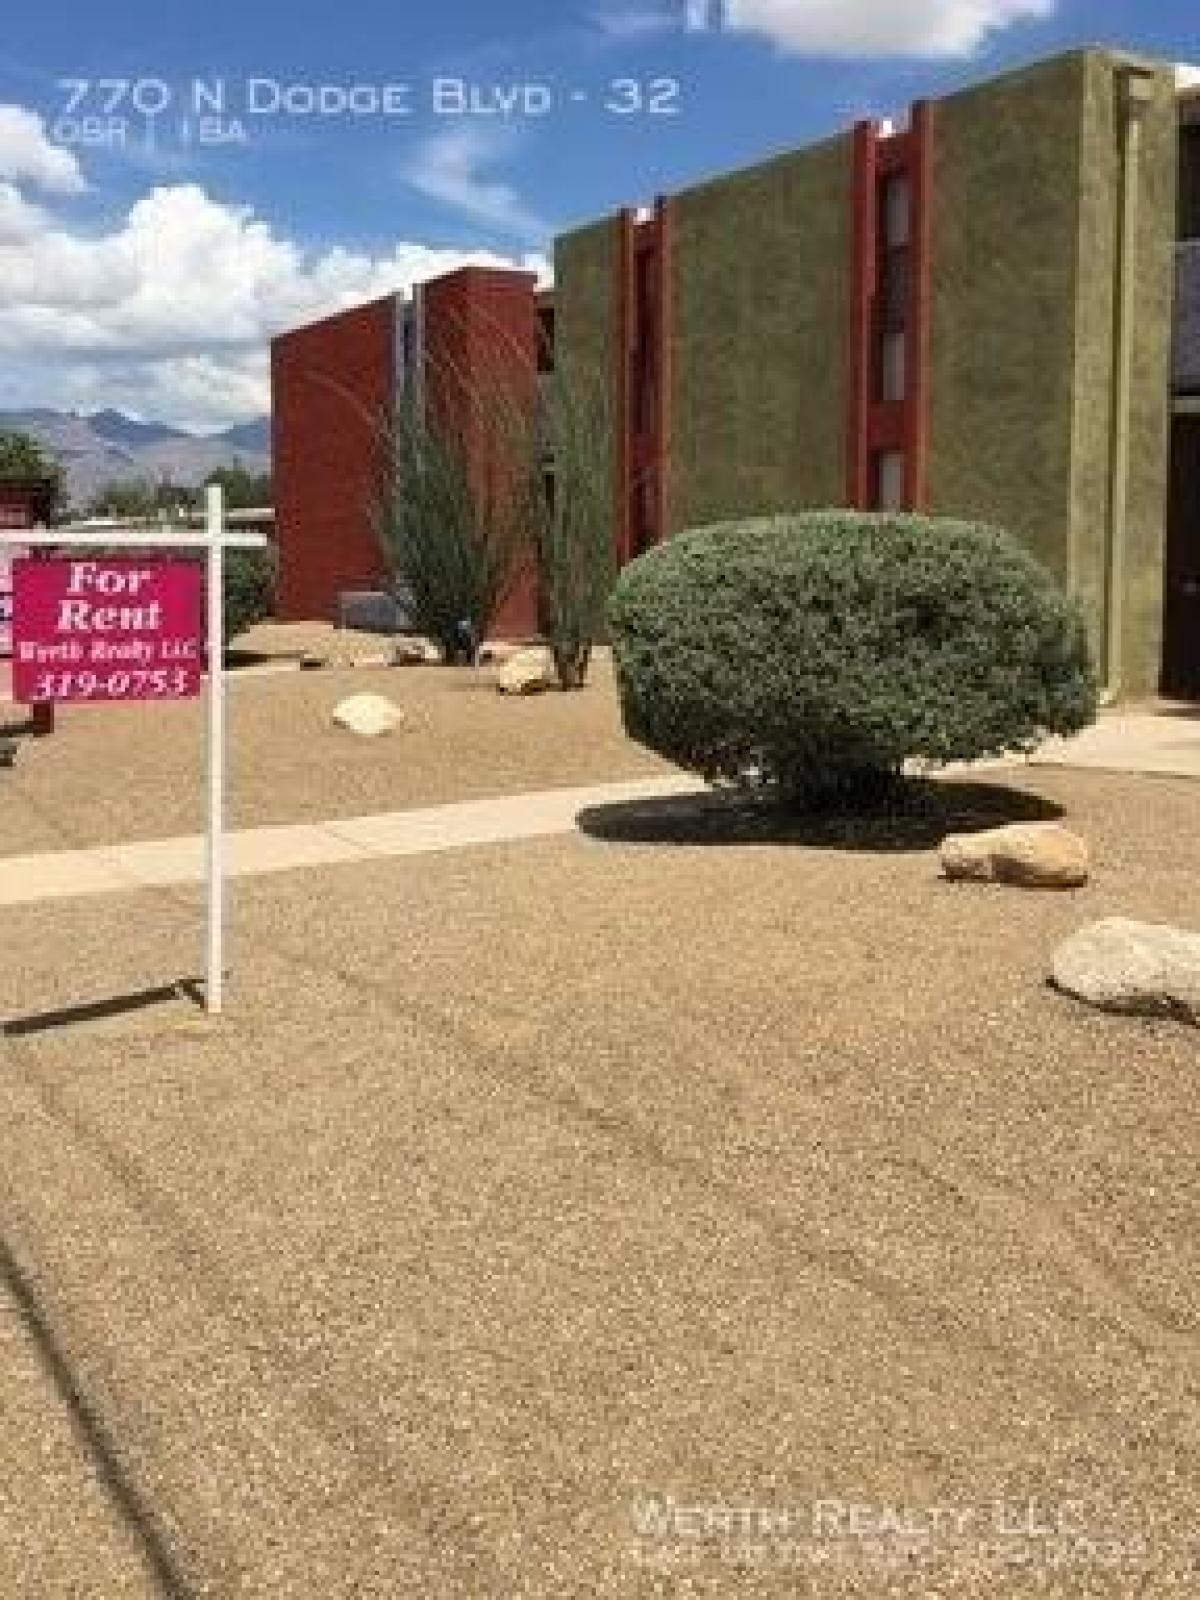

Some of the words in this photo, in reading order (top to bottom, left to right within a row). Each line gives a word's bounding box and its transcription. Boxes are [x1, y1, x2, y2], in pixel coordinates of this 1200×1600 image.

[66, 563, 152, 596] For
[57, 600, 163, 633] Rent
[90, 640, 152, 665] Realty
[34, 668, 189, 698] 319-0753
